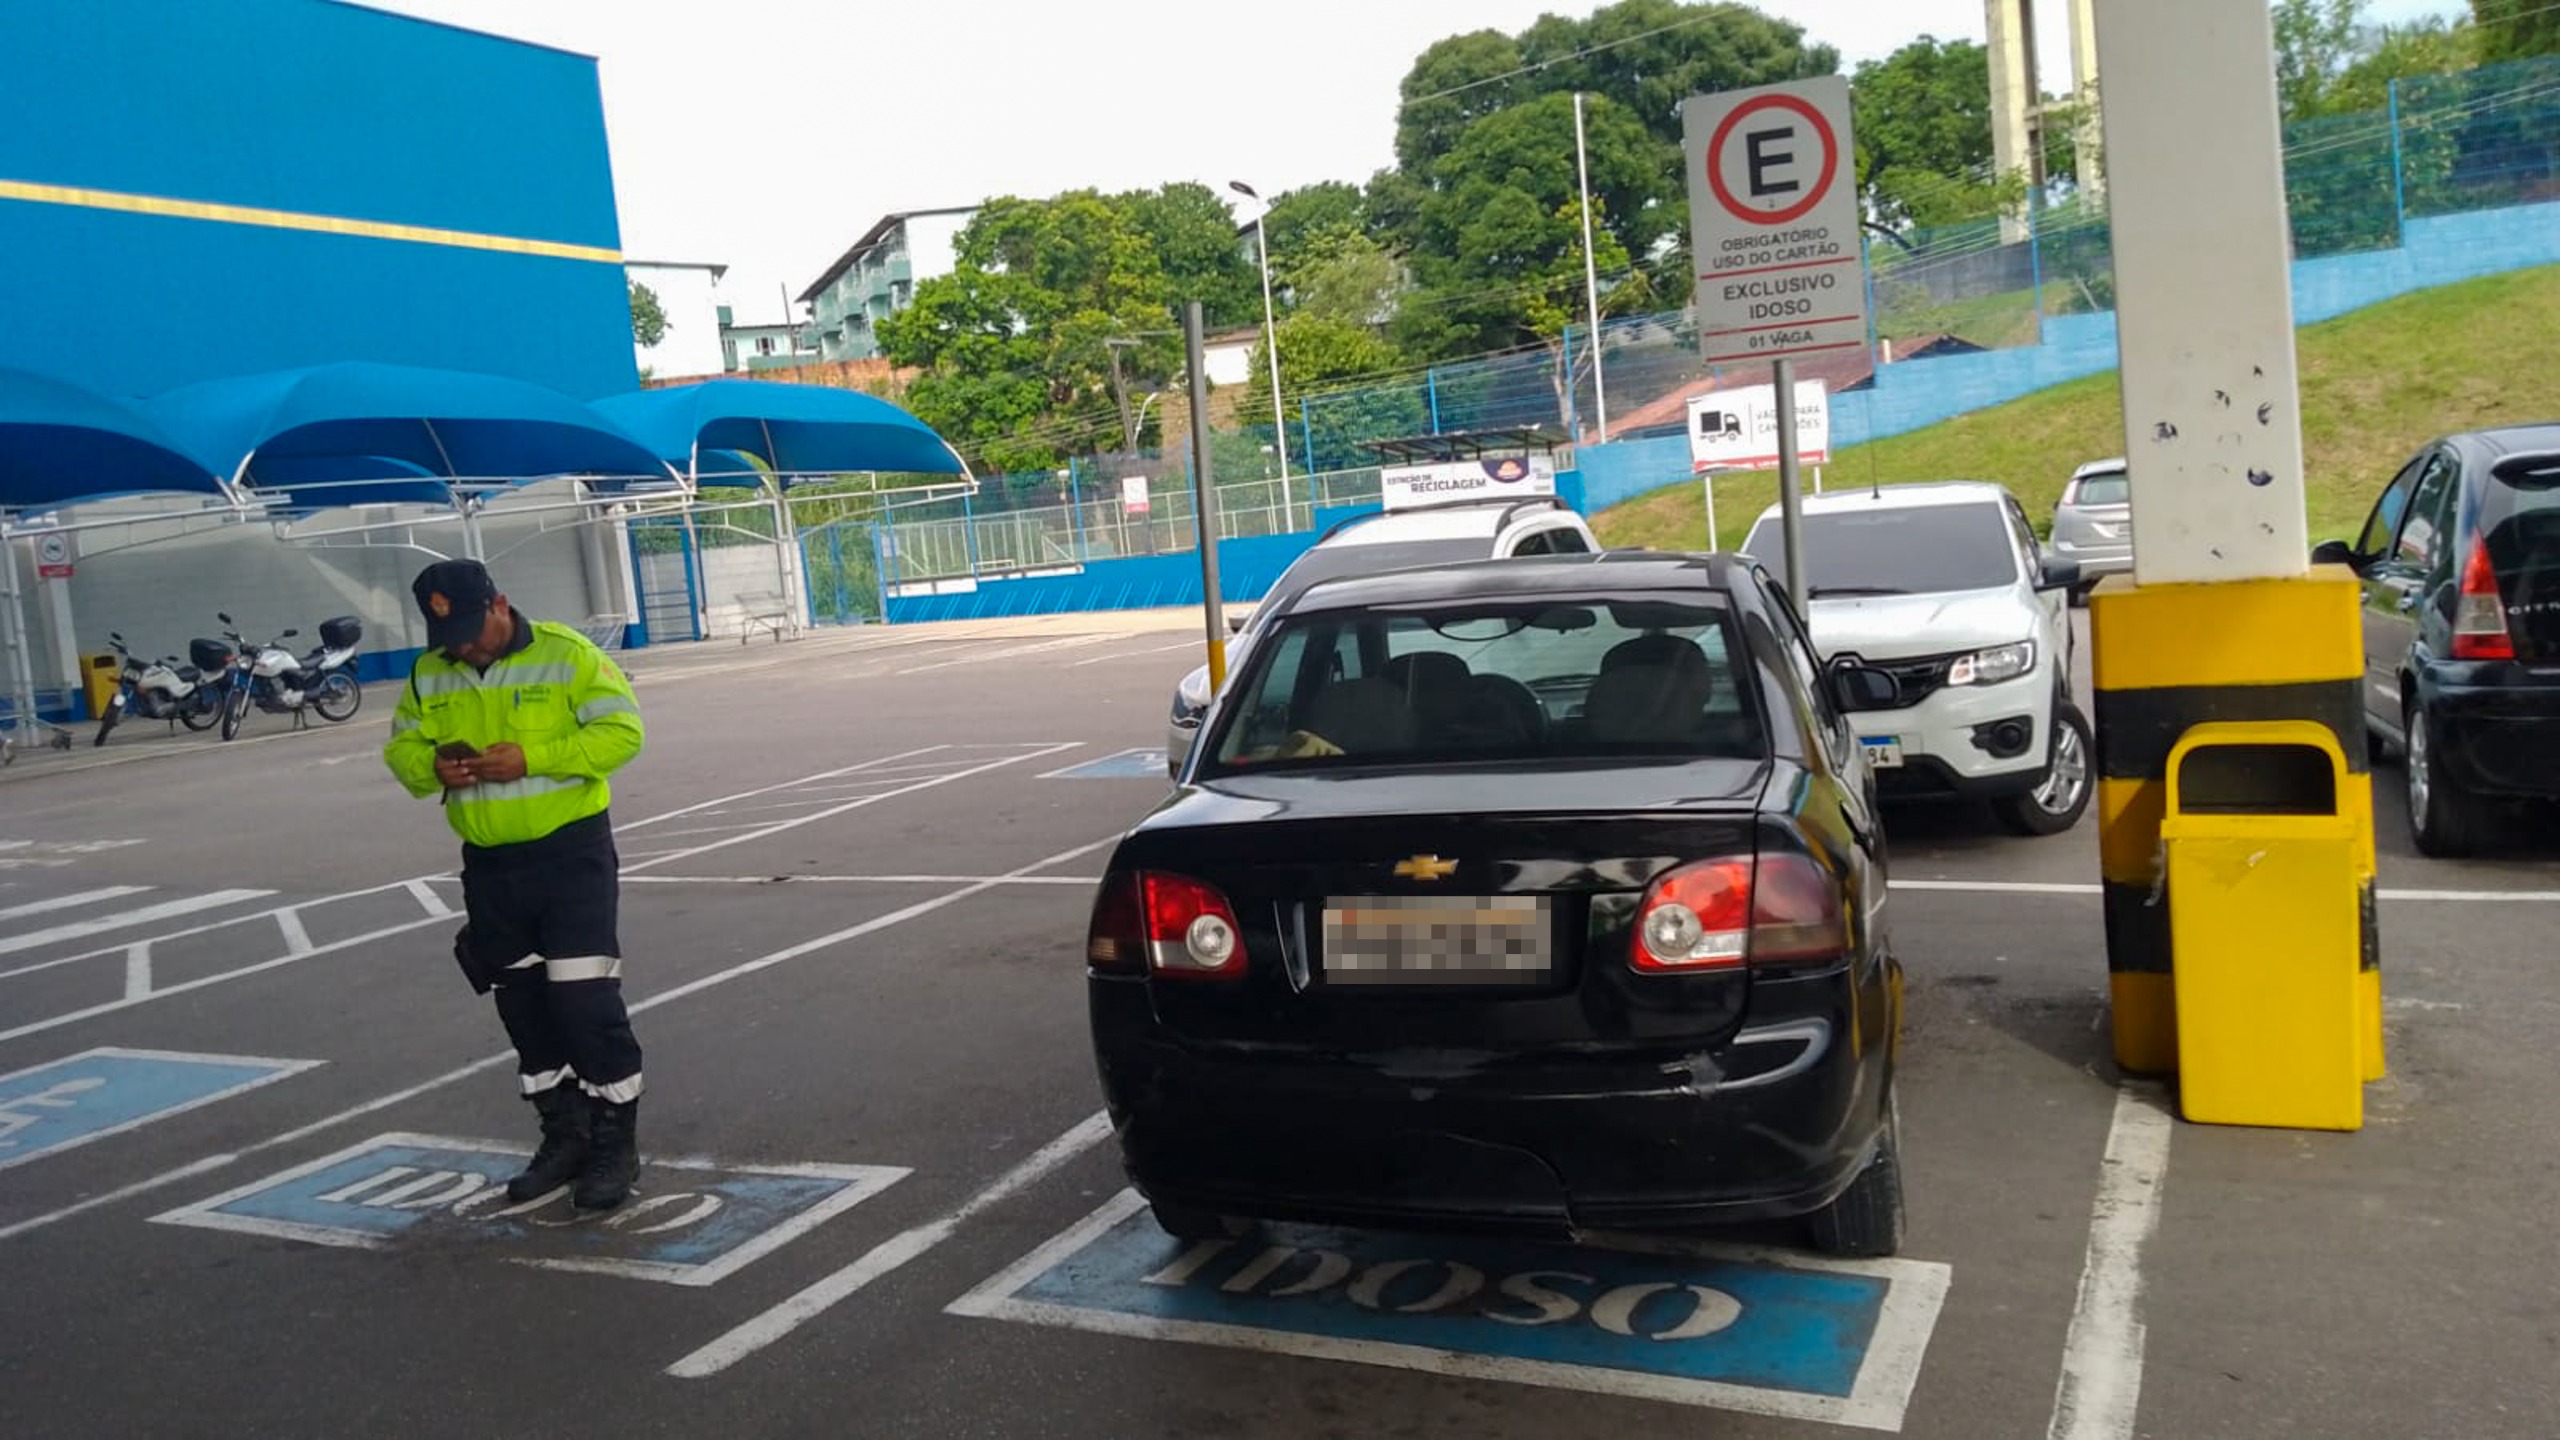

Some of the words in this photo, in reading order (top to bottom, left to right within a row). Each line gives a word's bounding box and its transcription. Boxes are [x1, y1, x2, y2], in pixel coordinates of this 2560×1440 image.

[1746, 125, 1799, 197] E
[1721, 226, 1829, 252] OBRIGATÓRIO
[1713, 254, 1745, 269] USO
[1749, 250, 1772, 265] DO
[1776, 241, 1839, 261] CARTÃO
[1723, 272, 1836, 301] EXCLUSIVO
[1749, 298, 1812, 320] IDOSO
[1749, 335, 1765, 348] 01
[1769, 330, 1814, 346] VAGA
[1410, 478, 1486, 493] RECICLAGEM
[1139, 1238, 1743, 1343] IDOSO
